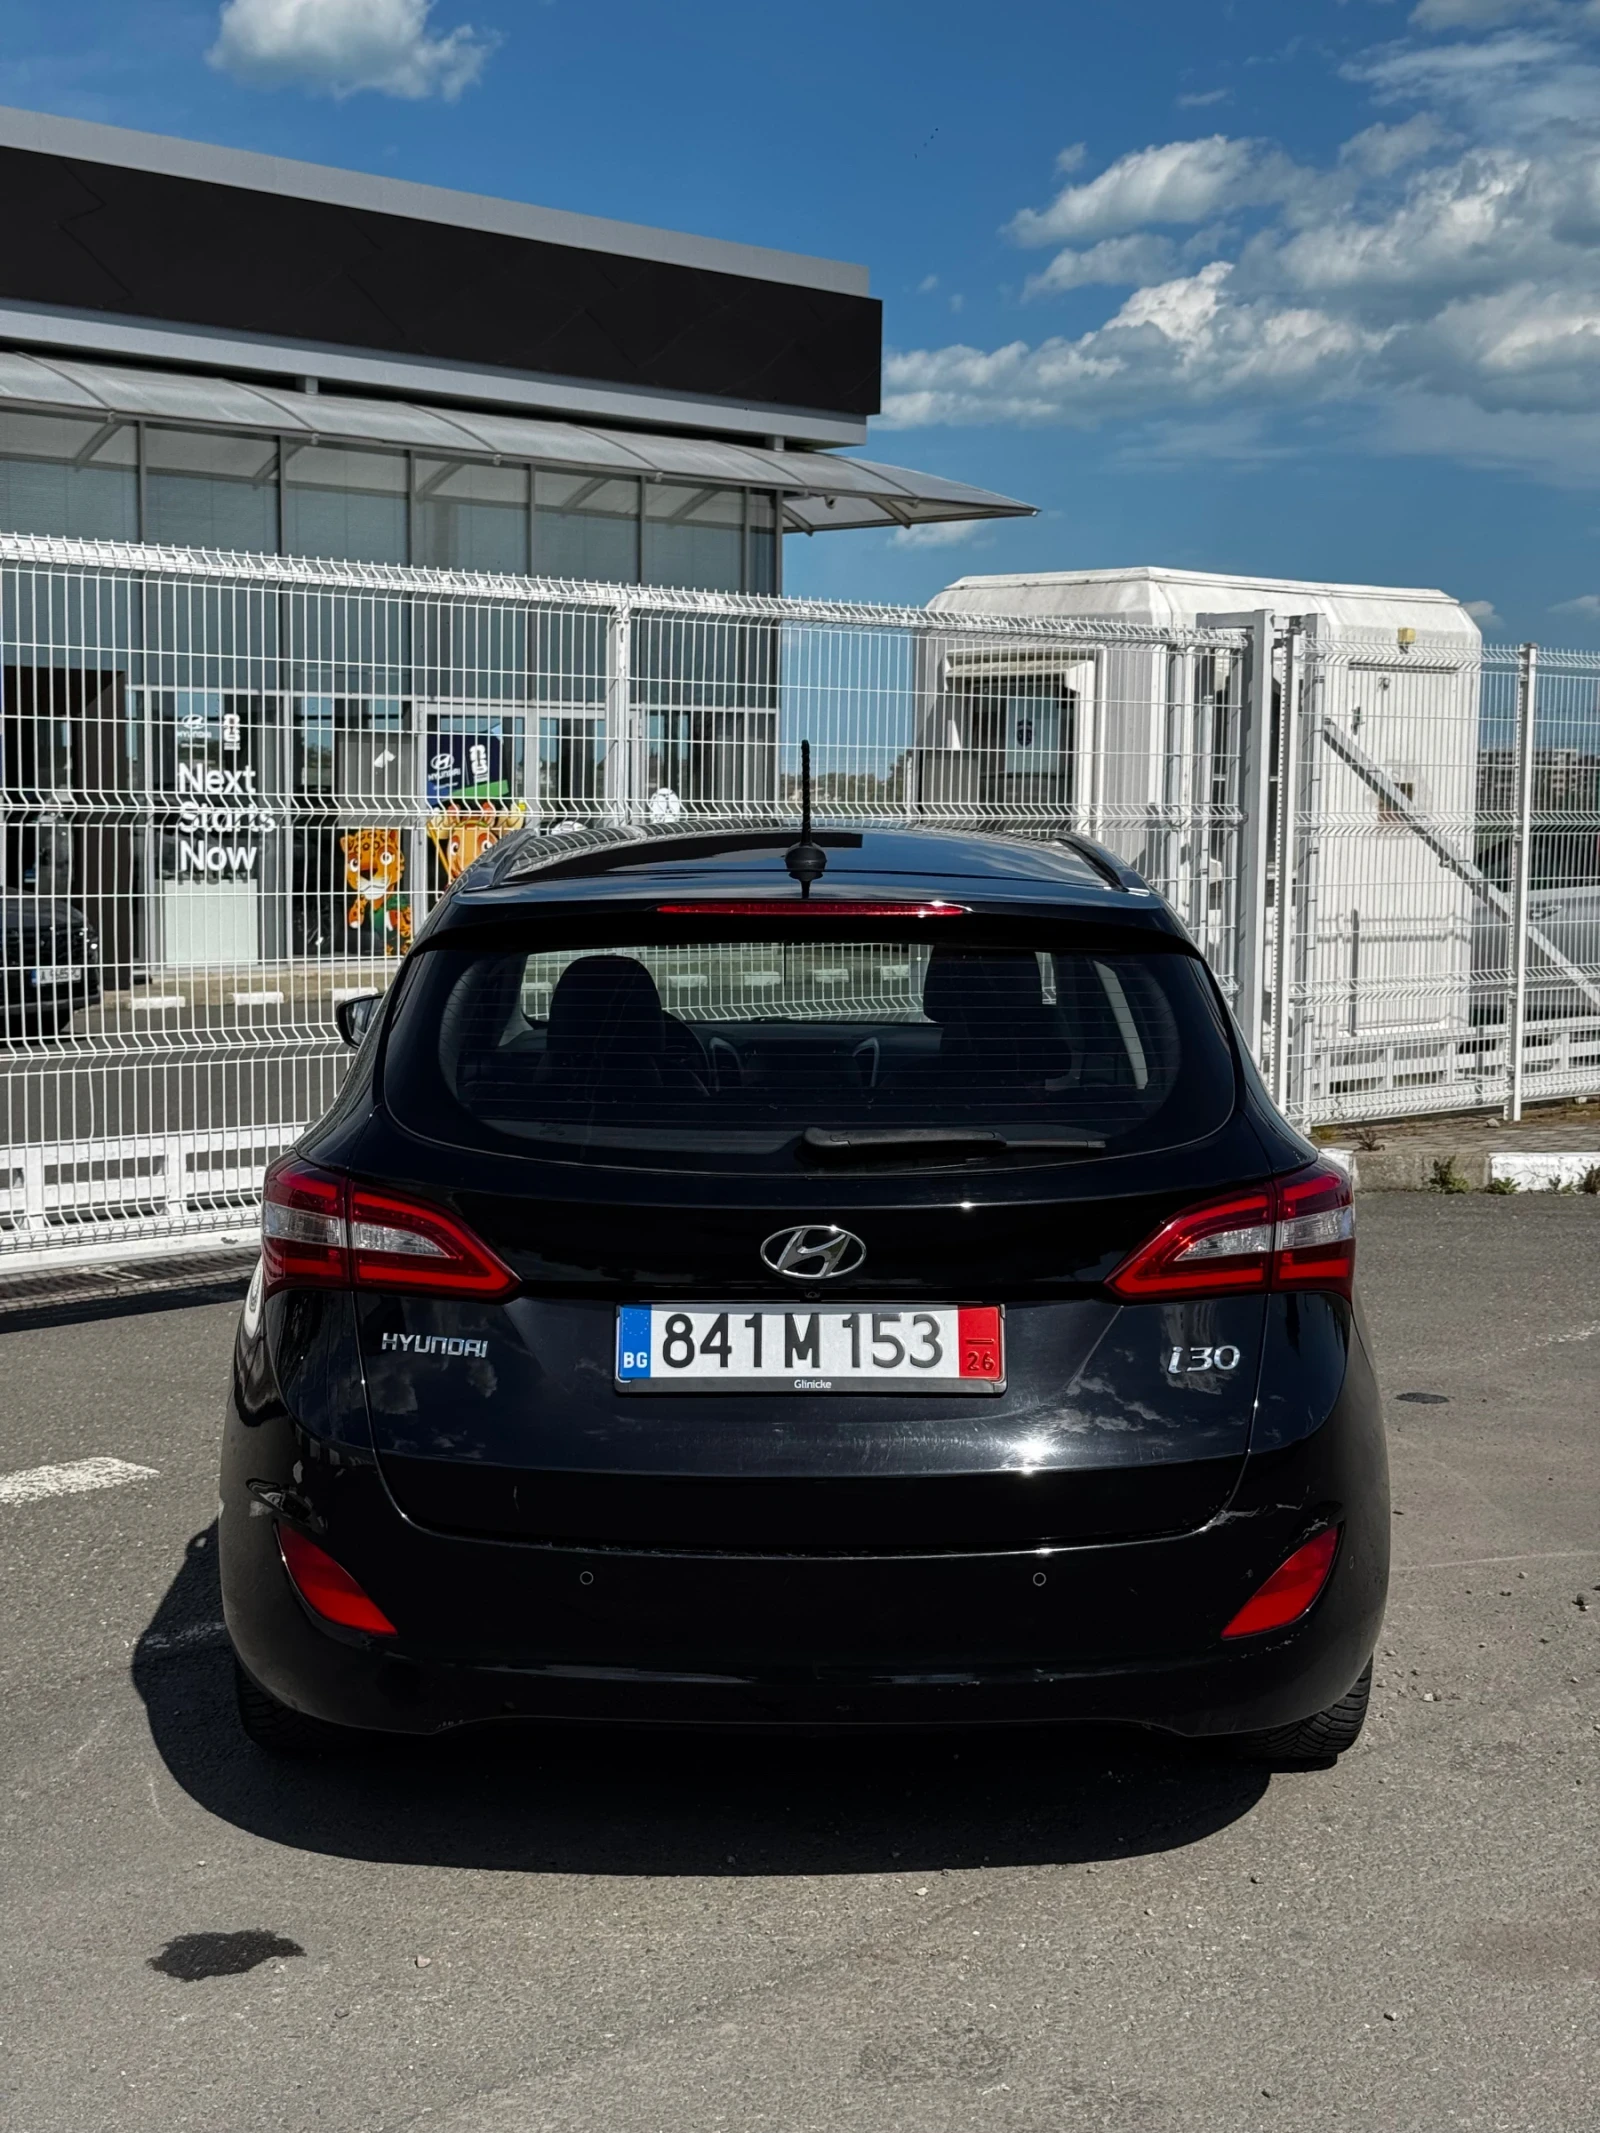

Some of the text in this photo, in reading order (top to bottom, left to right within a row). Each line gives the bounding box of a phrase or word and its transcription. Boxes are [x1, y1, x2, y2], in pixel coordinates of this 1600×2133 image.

[179, 762, 256, 794] Next
[180, 801, 276, 833] Starts
[180, 840, 257, 872] Now
[381, 1332, 488, 1358] HYUNDAI
[662, 1312, 944, 1369] 841 M 153
[623, 1352, 648, 1368] BG
[966, 1351, 995, 1371] 26
[1168, 1345, 1241, 1374] i30
[794, 1379, 832, 1389] Glinicke
